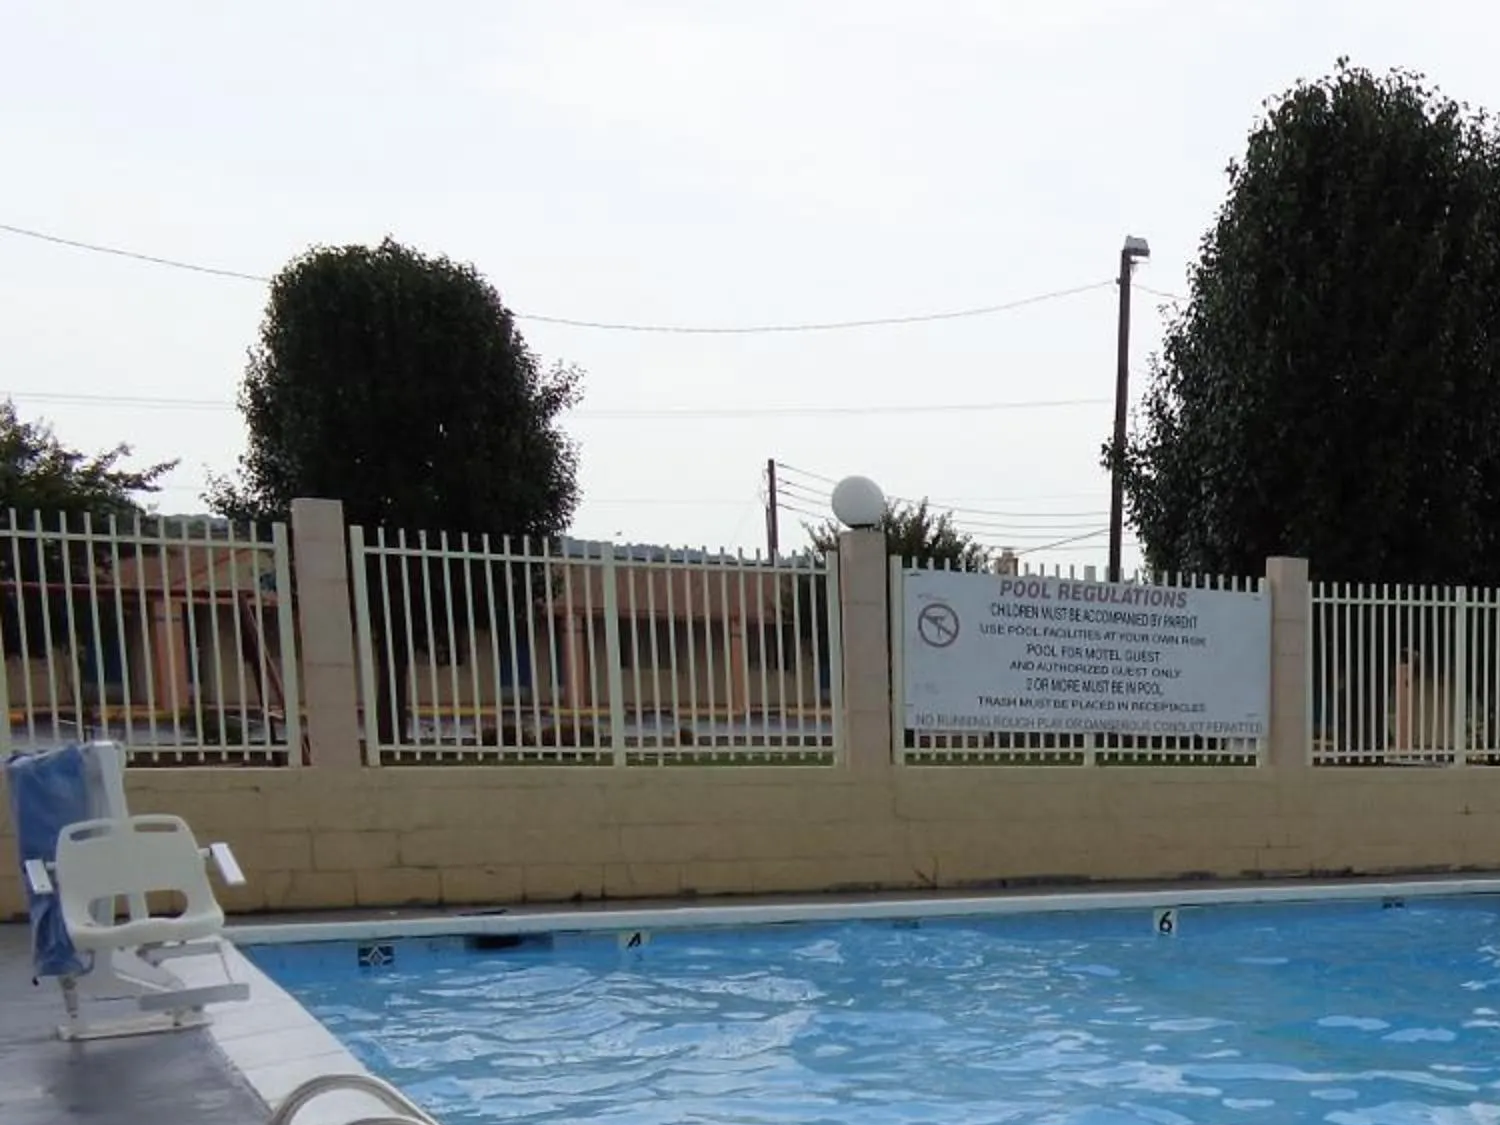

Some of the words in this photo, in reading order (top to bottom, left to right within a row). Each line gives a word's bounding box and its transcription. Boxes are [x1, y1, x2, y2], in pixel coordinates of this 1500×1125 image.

[1000, 579, 1051, 600] POOL
[1057, 582, 1188, 609] REGULATIONS
[990, 602, 1039, 619] CHILDREN
[1041, 605, 1067, 621] MUST
[1069, 607, 1081, 622] BE
[1083, 608, 1149, 627] ACCOMPANIED
[1151, 613, 1162, 627] BY
[1163, 614, 1198, 629] PARENT
[980, 622, 1005, 635] USE
[1008, 625, 1041, 637] POOL
[1044, 626, 1100, 641] FACILITIES
[1103, 630, 1117, 641] AT
[1120, 631, 1149, 643] YOUR
[1151, 634, 1179, 645] OWN
[1026, 643, 1057, 657] POOL
[1061, 646, 1082, 659] FOR
[1085, 647, 1122, 661] MOTEL
[1125, 649, 1160, 663] GUEST
[1009, 660, 1034, 671] AND
[1036, 662, 1109, 675] AUTHORIZED
[1151, 668, 1182, 679] ONLY
[1034, 678, 1048, 692] OR
[1051, 679, 1080, 693] MORE
[1082, 680, 1109, 693] MUST
[1111, 681, 1124, 695] BE
[1126, 682, 1137, 695] IN
[977, 695, 1016, 707] TRASH
[1019, 697, 1051, 709] MUST
[1053, 699, 1069, 709] BE
[1071, 700, 1115, 711] PLACED
[1118, 702, 1129, 712] IN
[915, 712, 934, 727] NO
[1160, 911, 1172, 932] 6
